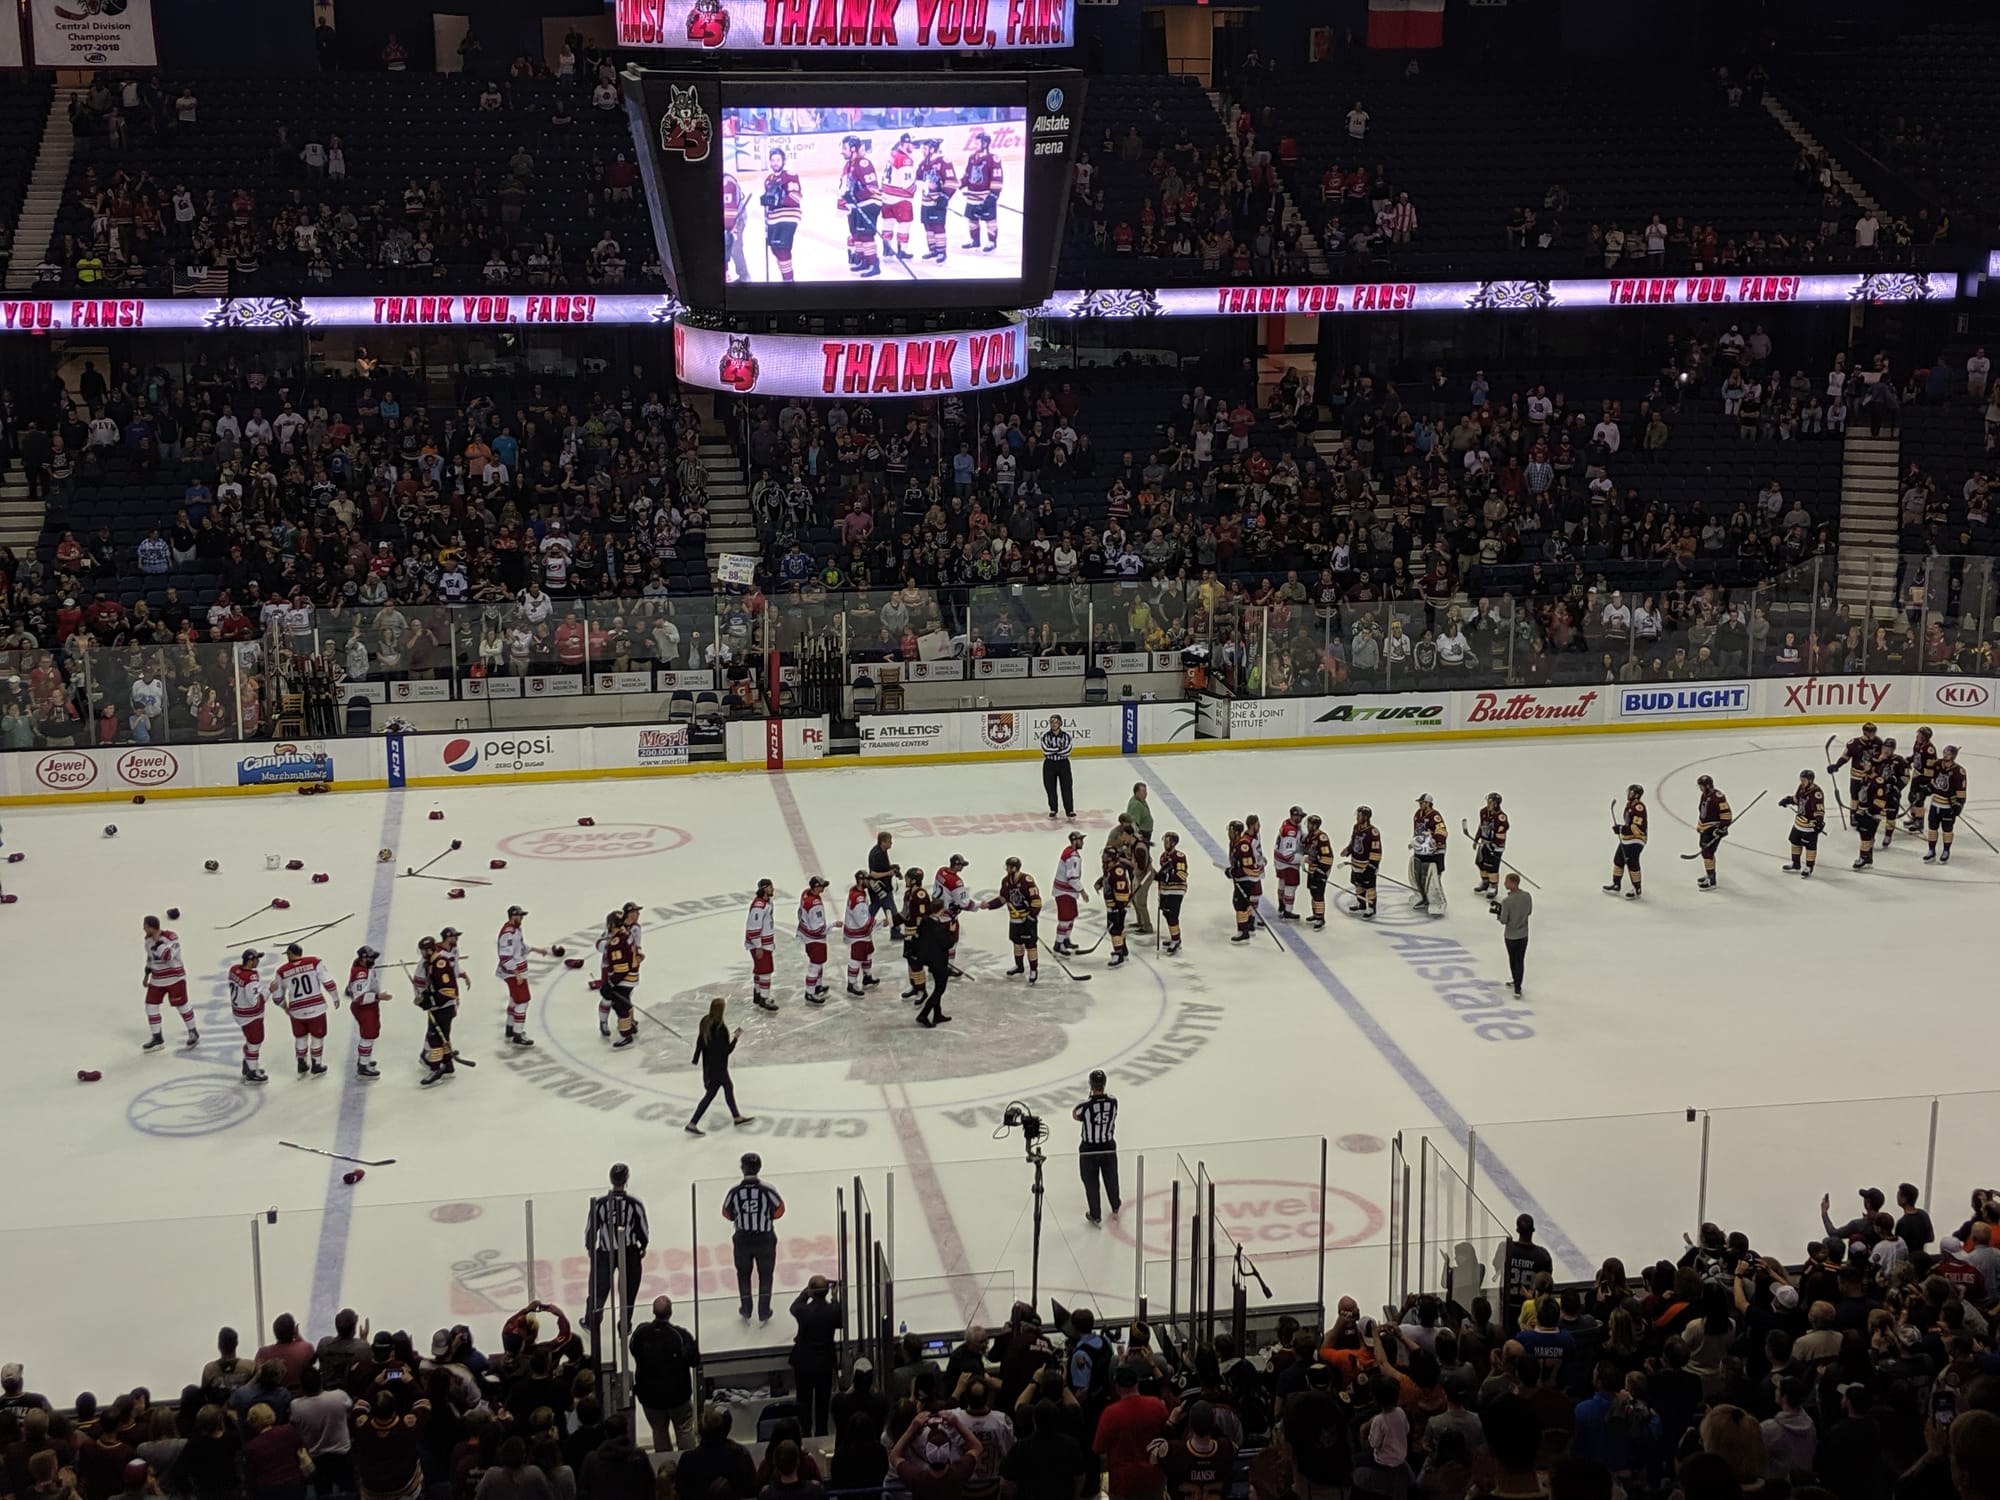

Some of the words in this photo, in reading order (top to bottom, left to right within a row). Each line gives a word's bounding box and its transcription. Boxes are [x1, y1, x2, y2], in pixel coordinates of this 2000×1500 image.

[55, 22, 90, 30] Central
[93, 22, 131, 30] Division
[618, 0, 664, 43] FANS!
[763, 0, 897, 46] THANK
[914, 0, 997, 50] YOU,
[1006, 0, 1065, 45] FANS!
[68, 33, 121, 42] Champions
[70, 43, 120, 51] 2017-2018
[1032, 114, 1070, 132] Allstate
[1034, 141, 1063, 155] arena
[1217, 288, 1290, 312] THANK
[1298, 286, 1344, 313] YOU,
[1352, 285, 1416, 310] FANS!
[1608, 280, 1676, 304] THANK
[1686, 278, 1731, 303] YOU,
[1738, 277, 1801, 301] FANS!
[3, 301, 61, 329] YOU,
[71, 300, 145, 328] FANS!
[373, 297, 455, 323] THANK
[463, 297, 517, 325] YOU,
[526, 296, 597, 321] FANS!
[822, 340, 957, 393] THANK
[968, 330, 1019, 387] YOU,
[1625, 692, 1674, 711] BUD
[1678, 689, 1744, 709] LIGHT
[1784, 676, 1892, 713] xfinity
[1945, 688, 1980, 702] KIA
[1249, 710, 1256, 718] &
[1259, 709, 1285, 717] JOINT
[1312, 705, 1444, 723] ATTURO
[1467, 691, 1598, 722] Butternut
[879, 725, 940, 737] ATHLETICS
[1034, 717, 1077, 729] LOLA
[1126, 708, 1134, 745] CCM
[485, 736, 552, 761] pepsi
[771, 723, 780, 760] CCM
[868, 740, 900, 749] TRAINING
[901, 739, 930, 748] CENTERS
[44, 758, 87, 773] Jewel
[125, 755, 167, 770] Jewel
[243, 752, 314, 772] Campfire
[391, 740, 400, 778] CCM
[47, 768, 88, 783] Osco
[128, 766, 167, 779] Osco
[523, 828, 657, 845] Jewel
[532, 841, 655, 855] Osco
[291, 974, 313, 999] 20
[1376, 930, 1536, 1041] Allstate
[1108, 1001, 1224, 1087] ALLSTATE
[1094, 1111, 1110, 1124] 45
[741, 1200, 759, 1213] 42
